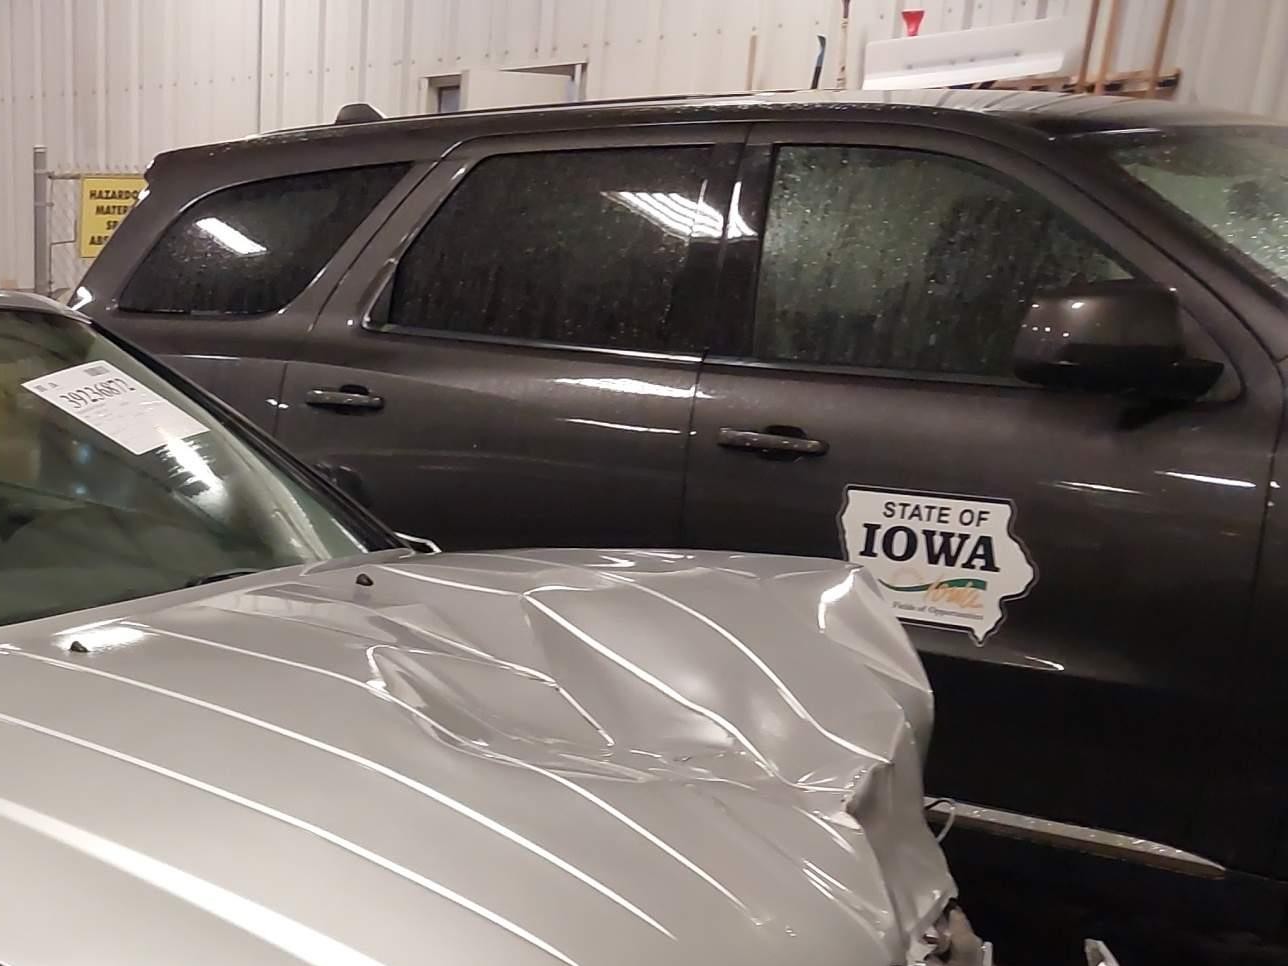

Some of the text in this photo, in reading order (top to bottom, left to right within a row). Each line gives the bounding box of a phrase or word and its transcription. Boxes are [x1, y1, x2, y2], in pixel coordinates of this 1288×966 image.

[90, 190, 140, 200] HAZARDO
[96, 205, 127, 215] MATER
[59, 378, 137, 409] 39236872
[883, 502, 990, 527] STATE OF
[859, 523, 1000, 573] IOWA
